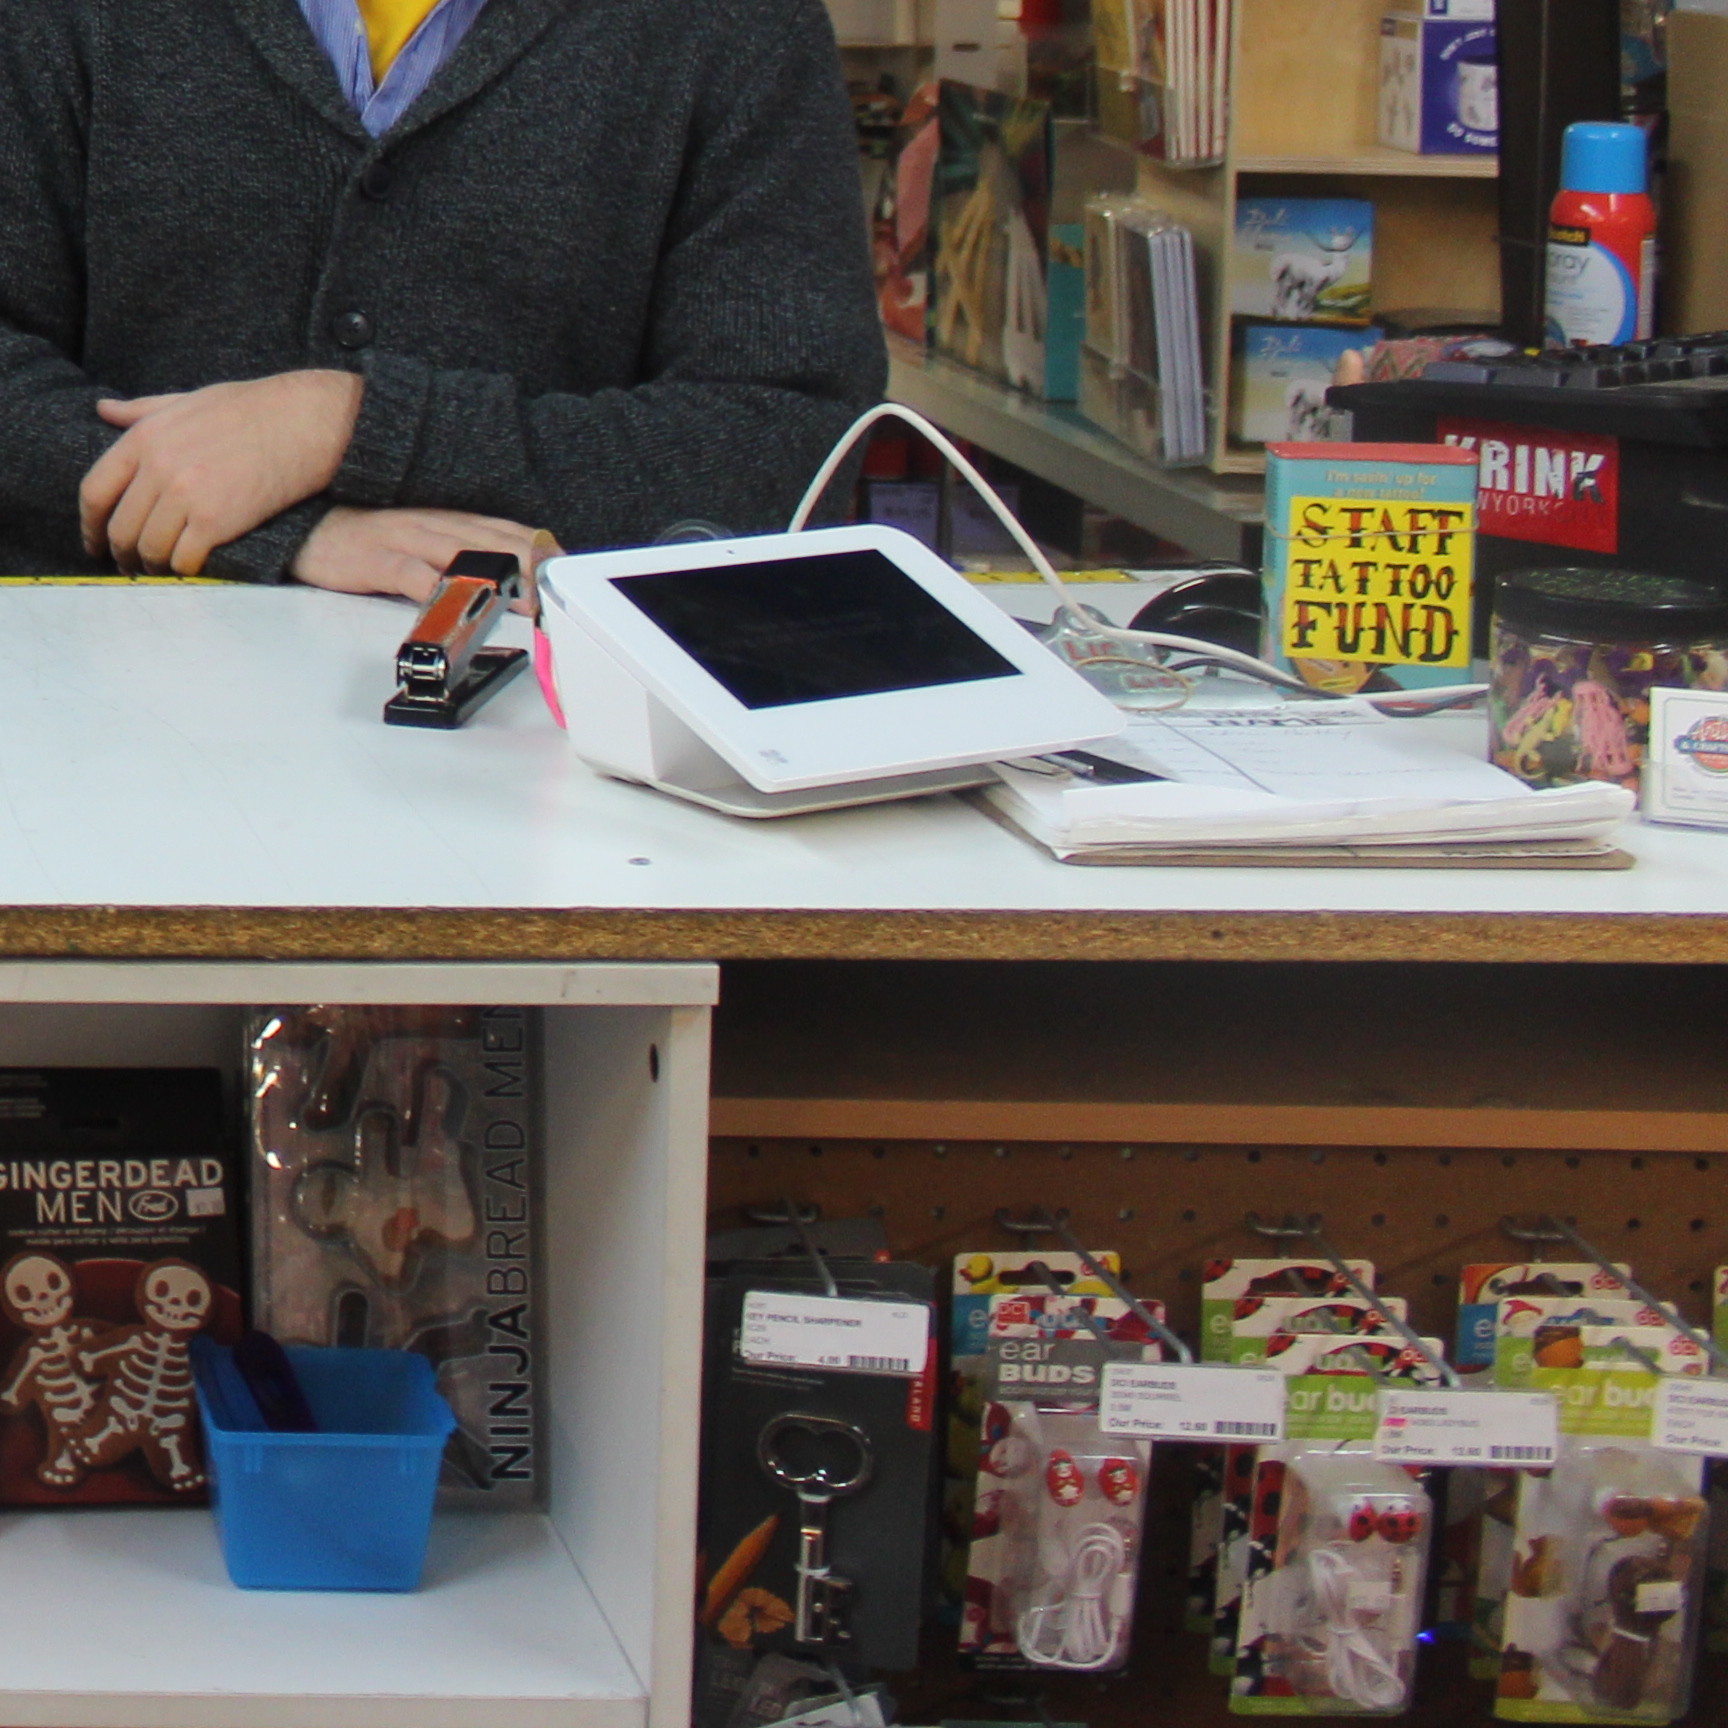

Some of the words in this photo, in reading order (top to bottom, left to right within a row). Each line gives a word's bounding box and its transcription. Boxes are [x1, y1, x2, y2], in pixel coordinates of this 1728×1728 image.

[1296, 503, 1464, 557] STAFF
[1292, 558, 1456, 602] TATTOO
[1291, 599, 1460, 663] FUND
[35, 1189, 123, 1224] MEN
[485, 1118, 532, 1481] NINJABREAD
[998, 1341, 1056, 1361] ear
[998, 1363, 1097, 1384] BUDS
